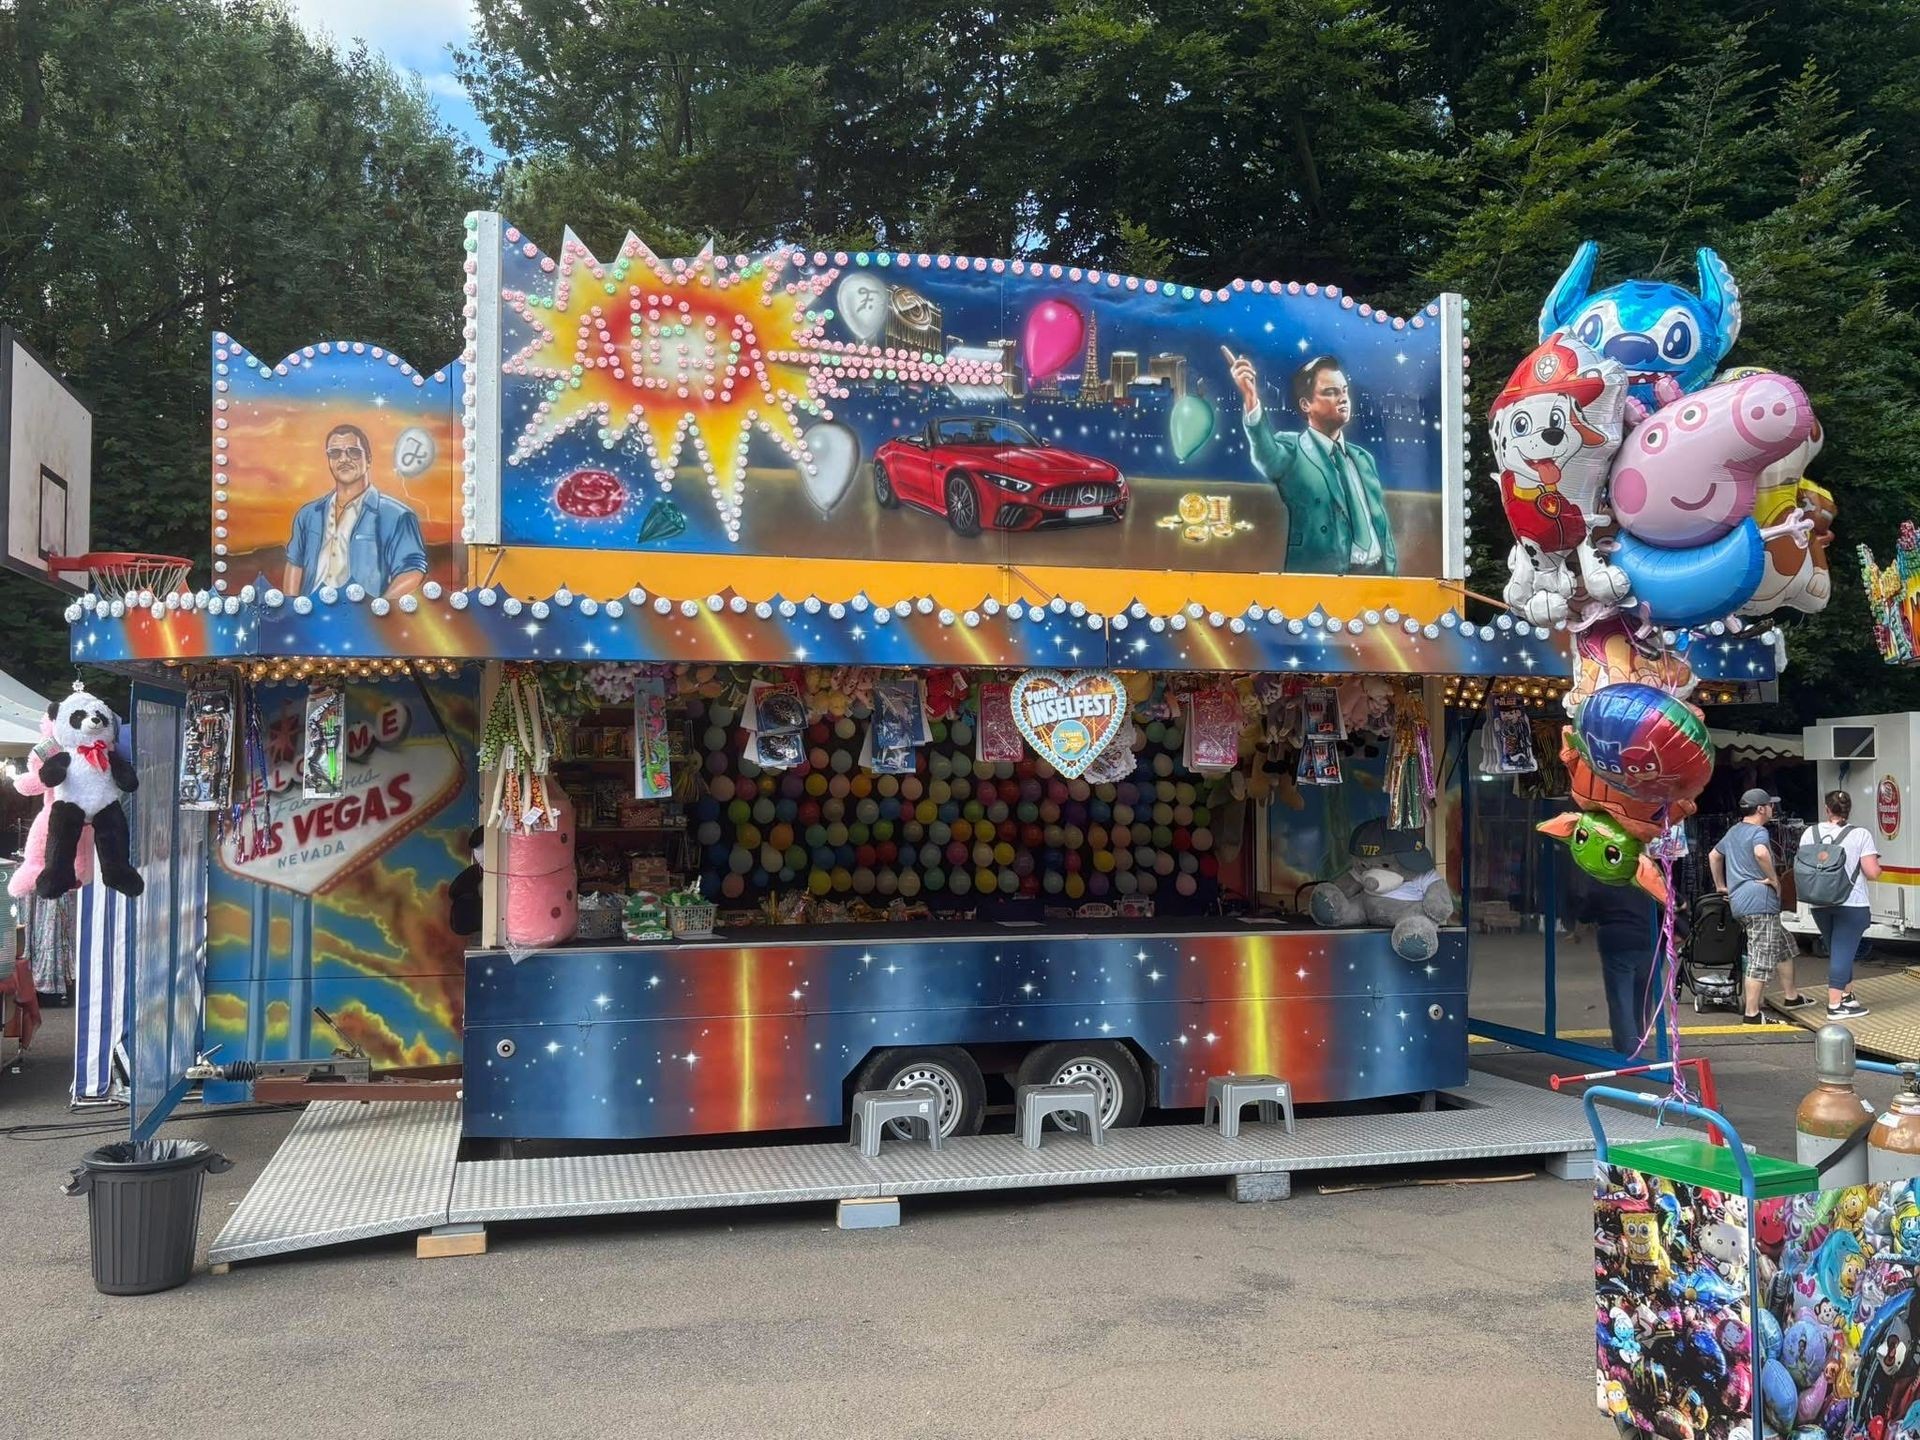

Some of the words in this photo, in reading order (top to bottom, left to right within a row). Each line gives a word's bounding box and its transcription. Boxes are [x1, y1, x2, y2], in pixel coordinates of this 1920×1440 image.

[1025, 687, 1059, 704] Porzer
[1029, 694, 1113, 728] INSELFEST
[234, 822, 283, 865] LAS
[293, 773, 414, 846] VEGAS
[277, 841, 346, 869] NEVADA
[1360, 844, 1381, 856] VIP
